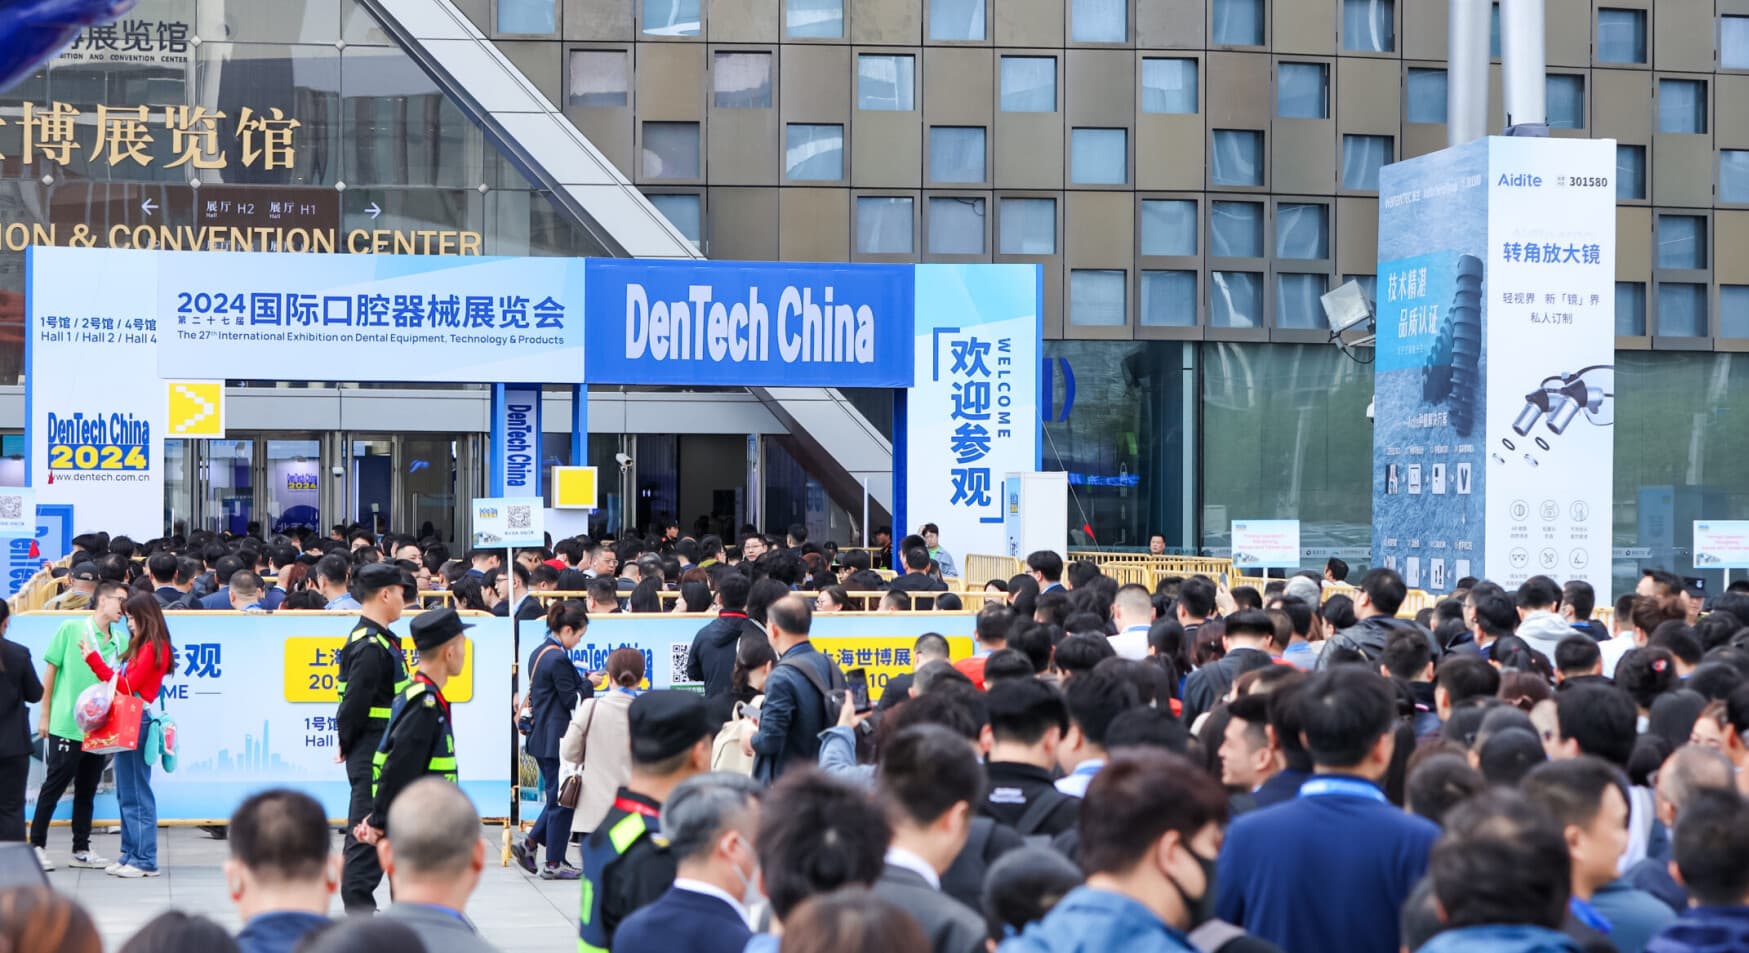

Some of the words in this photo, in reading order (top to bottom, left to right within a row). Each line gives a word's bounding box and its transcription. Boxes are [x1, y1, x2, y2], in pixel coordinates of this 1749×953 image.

[72, 20, 188, 53] 展览馆
[0, 100, 302, 171] 博展览馆
[1498, 174, 1542, 187] Aidite
[1569, 177, 1608, 187] 301580
[206, 201, 231, 213] 展厅
[237, 203, 255, 215] H2
[270, 202, 295, 214] 展厅
[301, 204, 316, 216] H1
[69, 224, 98, 248] &
[109, 224, 336, 255] CONVENTION
[347, 228, 482, 257] CENTER
[1503, 242, 1601, 265] 转角放大镜
[1503, 293, 1535, 304] 轻视界
[40, 316, 71, 329] 1号馆
[81, 317, 114, 330] 2号馆
[124, 318, 157, 331] 4号馆
[625, 284, 768, 362] DenTech
[777, 286, 874, 364] China
[1531, 312, 1573, 325] 私人订制
[41, 331, 64, 342] Hall
[82, 332, 105, 343] Hall
[108, 333, 115, 343] 2
[125, 333, 147, 344] Hall
[150, 334, 157, 344] 4
[177, 330, 197, 340] The
[218, 331, 285, 342] International
[287, 332, 339, 342] Exhibition
[340, 334, 354, 342] on
[355, 333, 388, 343] Dental
[390, 333, 448, 345] Equipment,
[451, 334, 508, 347] Technology
[509, 335, 517, 344] &
[518, 335, 565, 345] Products
[998, 338, 1011, 438] WELCOME
[48, 412, 106, 444] DenTech
[110, 412, 150, 445] China
[507, 405, 532, 451] DenTech
[950, 336, 992, 507] 欢迎参观
[50, 445, 146, 469] 2024
[507, 454, 532, 487] China
[305, 735, 333, 747] Hall
